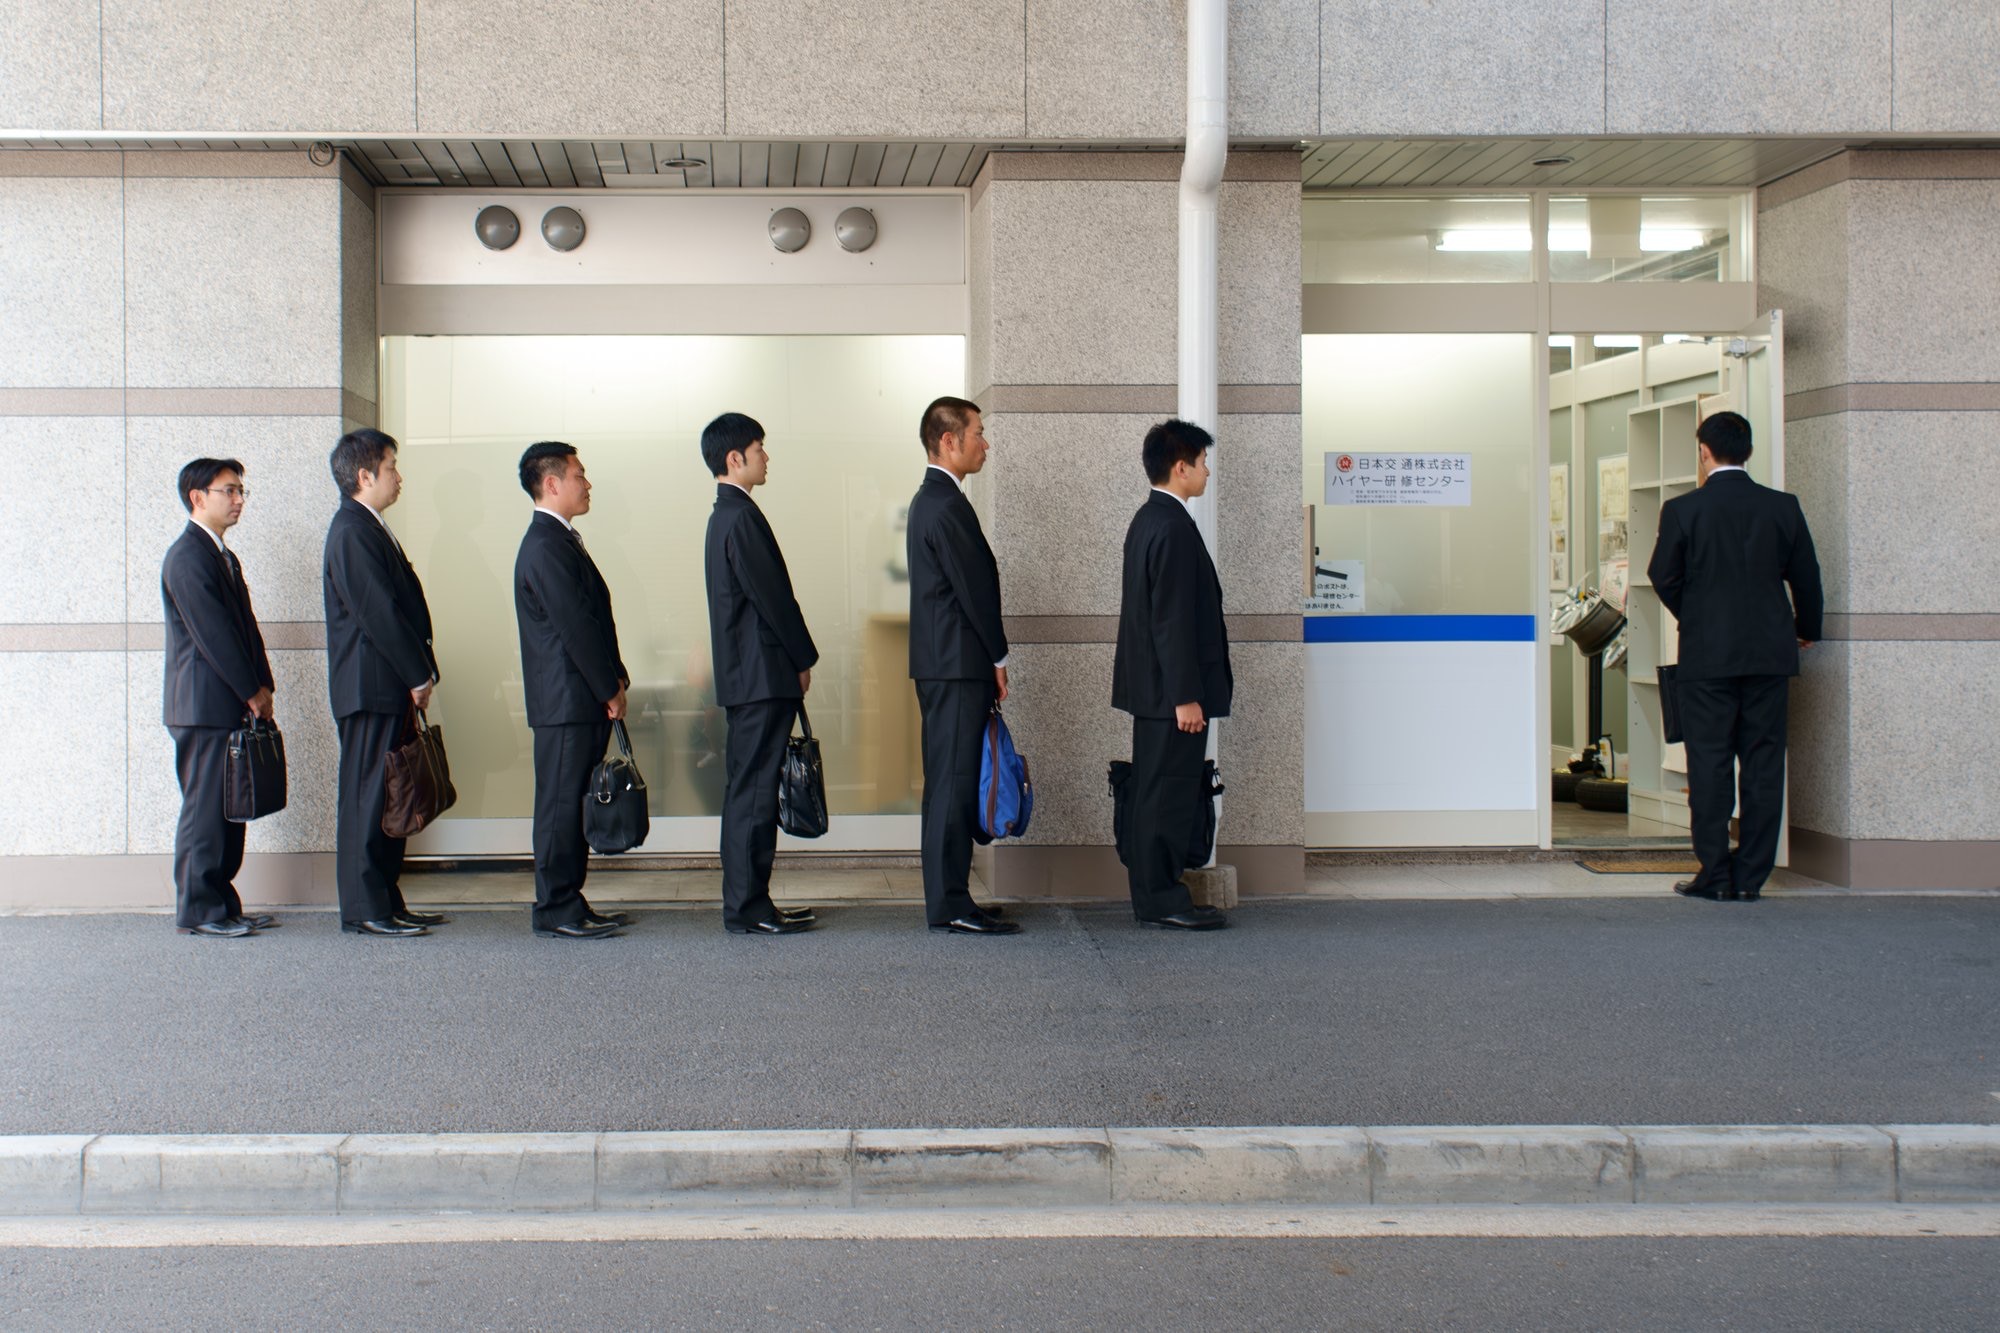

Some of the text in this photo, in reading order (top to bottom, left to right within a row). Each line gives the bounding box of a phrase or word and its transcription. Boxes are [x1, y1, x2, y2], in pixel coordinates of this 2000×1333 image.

[1359, 458, 1465, 471] 日本交通株式会社
[1332, 475, 1465, 487] ハイヤー研修センター
